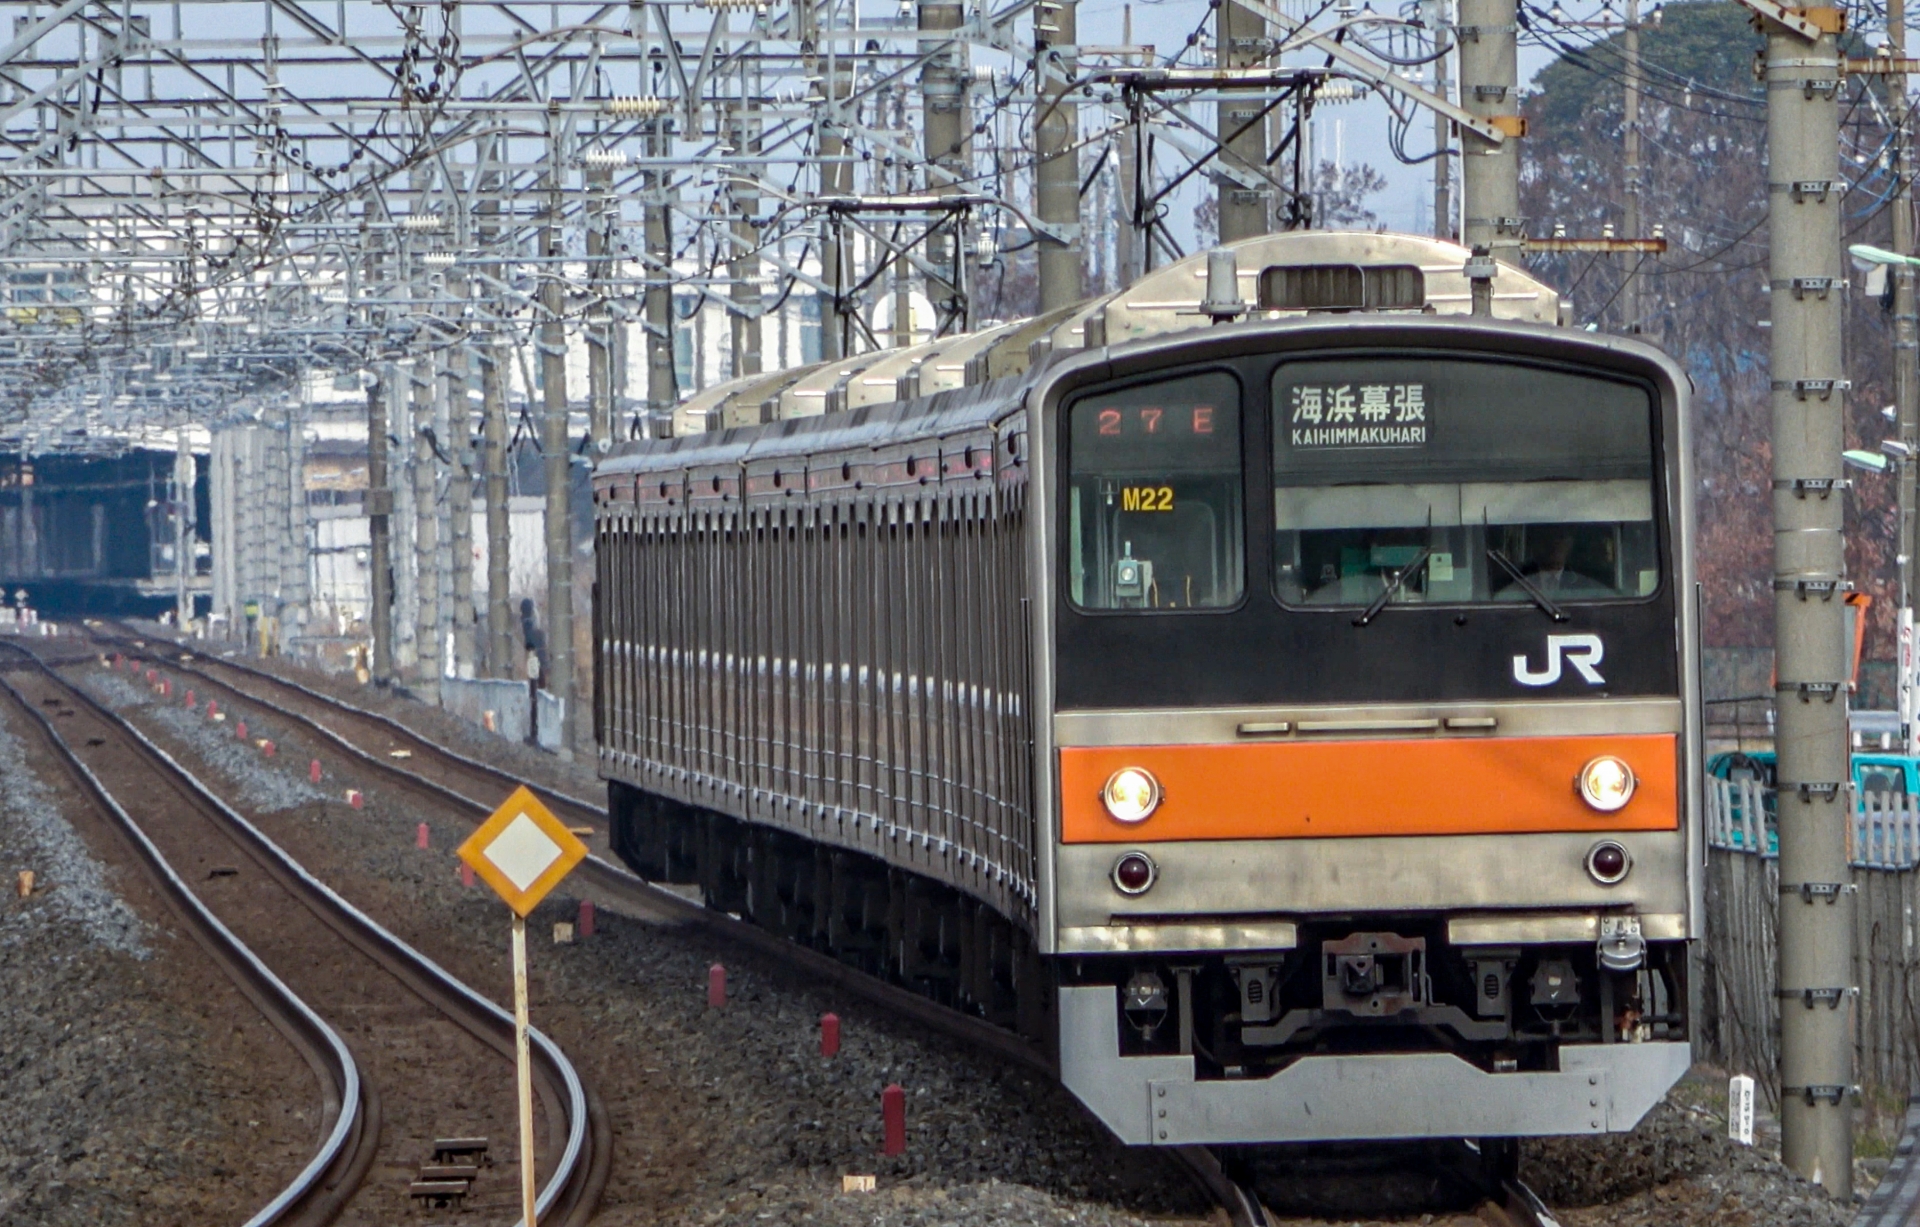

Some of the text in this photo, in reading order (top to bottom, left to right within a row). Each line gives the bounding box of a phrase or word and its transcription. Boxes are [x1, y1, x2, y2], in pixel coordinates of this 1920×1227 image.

[1292, 385, 1426, 424] 海浜幕張
[1292, 427, 1426, 445] KAIHIMMAKUHARI
[1123, 486, 1173, 511] M22
[1513, 634, 1606, 686] JR
